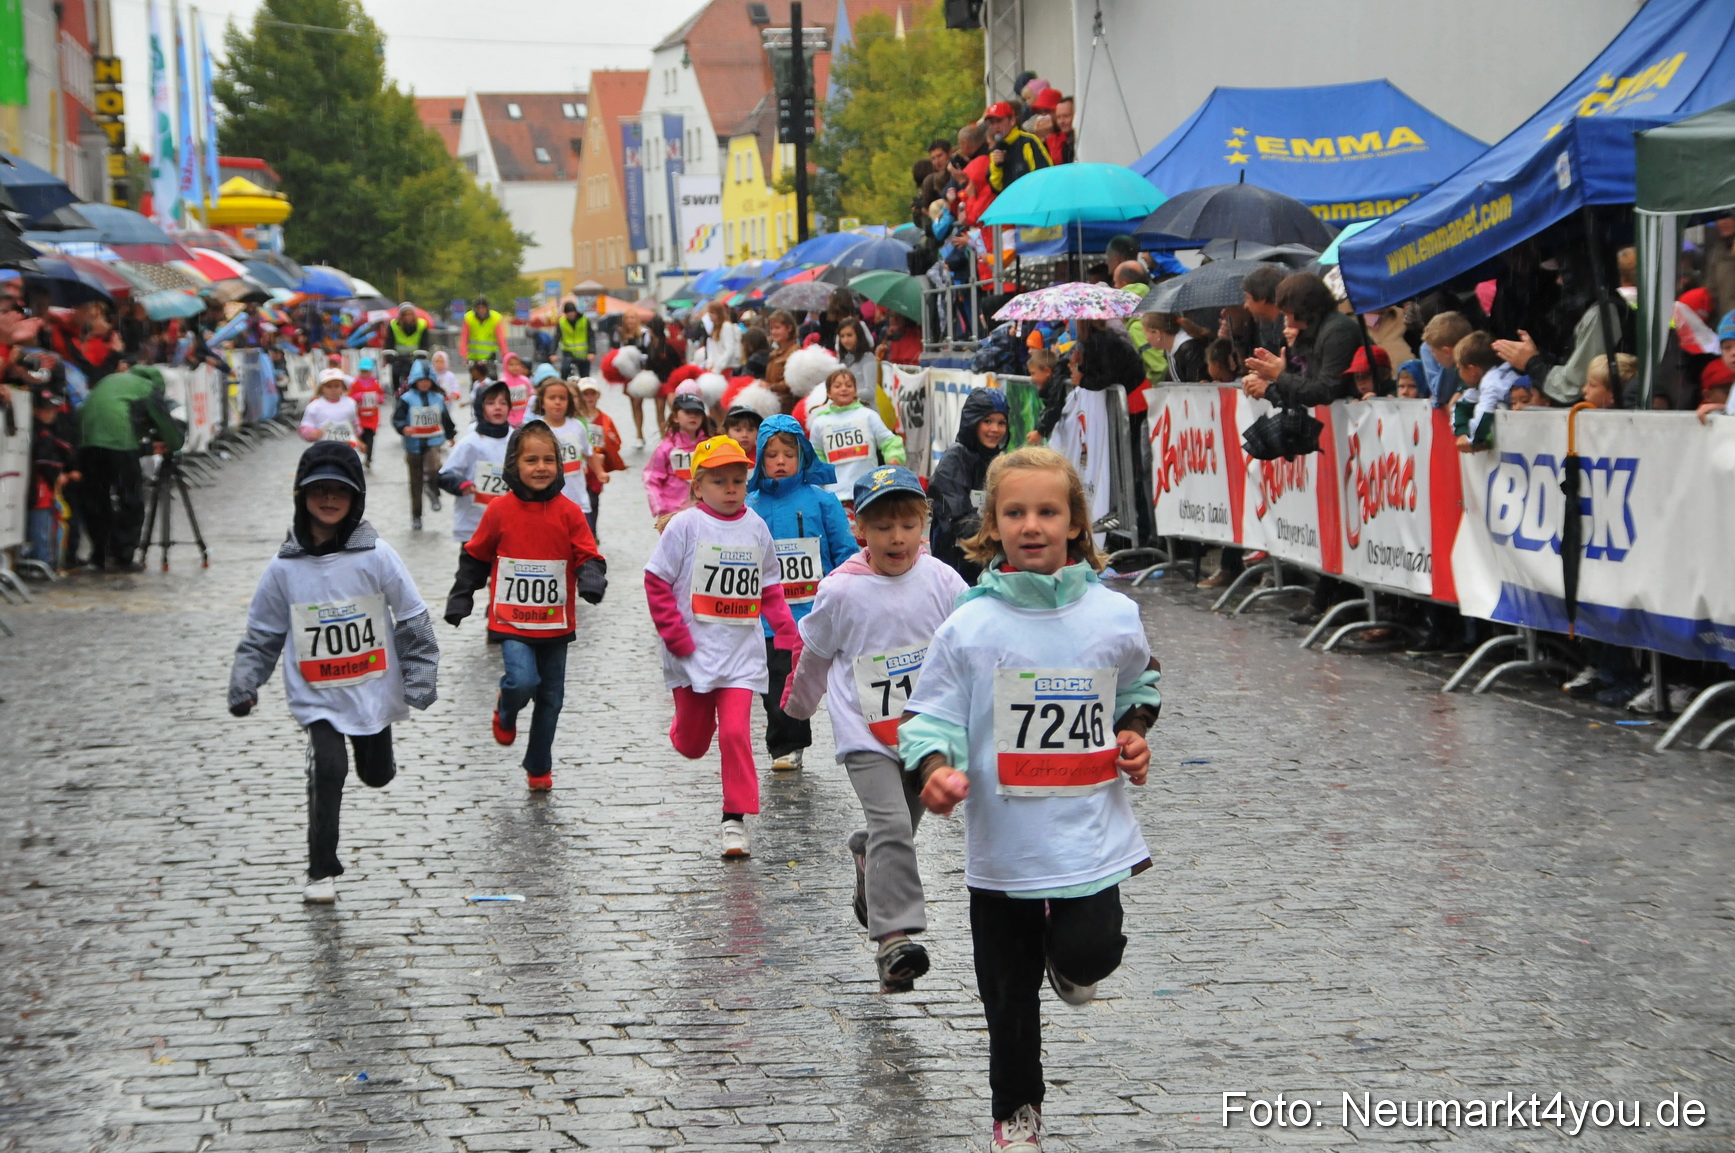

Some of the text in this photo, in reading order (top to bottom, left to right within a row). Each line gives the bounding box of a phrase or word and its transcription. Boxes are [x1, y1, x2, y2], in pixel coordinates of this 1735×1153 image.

[1255, 126, 1425, 156] EMMA
[826, 429, 864, 450] 7056
[720, 551, 753, 561] BOCK
[514, 564, 546, 572] BOCK
[505, 577, 558, 604] 7008
[704, 565, 759, 596] 7086
[512, 608, 547, 622] Sophia
[715, 601, 749, 614] Celina
[304, 618, 376, 657] 7004
[1035, 678, 1093, 692] BOCK
[1010, 703, 1106, 749] 7246
